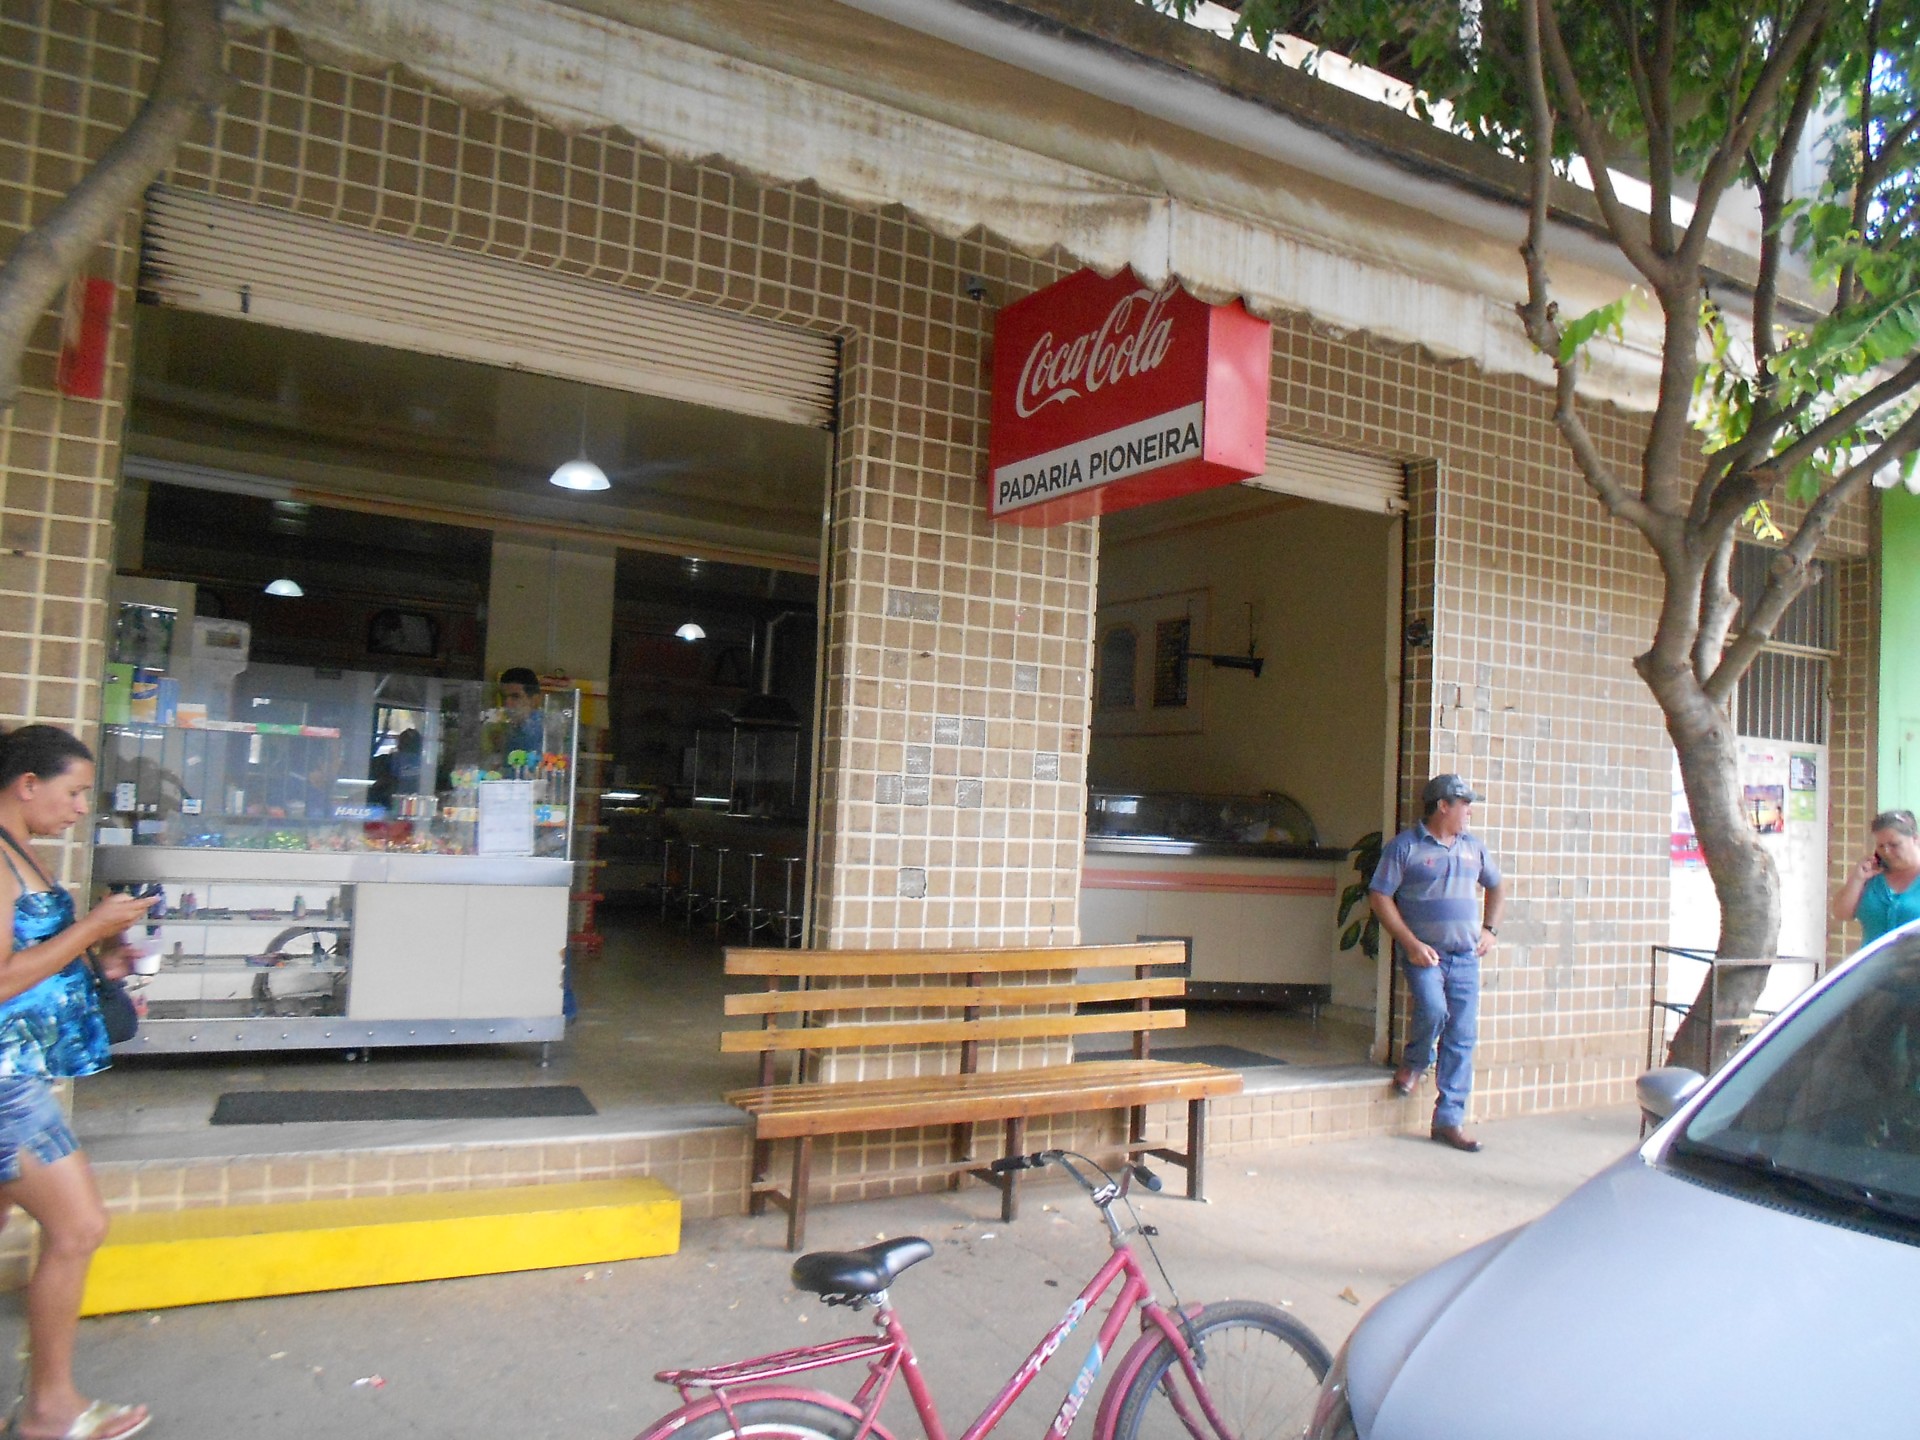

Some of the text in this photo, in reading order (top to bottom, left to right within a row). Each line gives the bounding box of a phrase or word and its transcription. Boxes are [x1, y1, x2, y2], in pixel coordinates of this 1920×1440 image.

[1016, 277, 1178, 418] Coca-Cola
[999, 422, 1200, 505] PADARIA PIONEIRA
